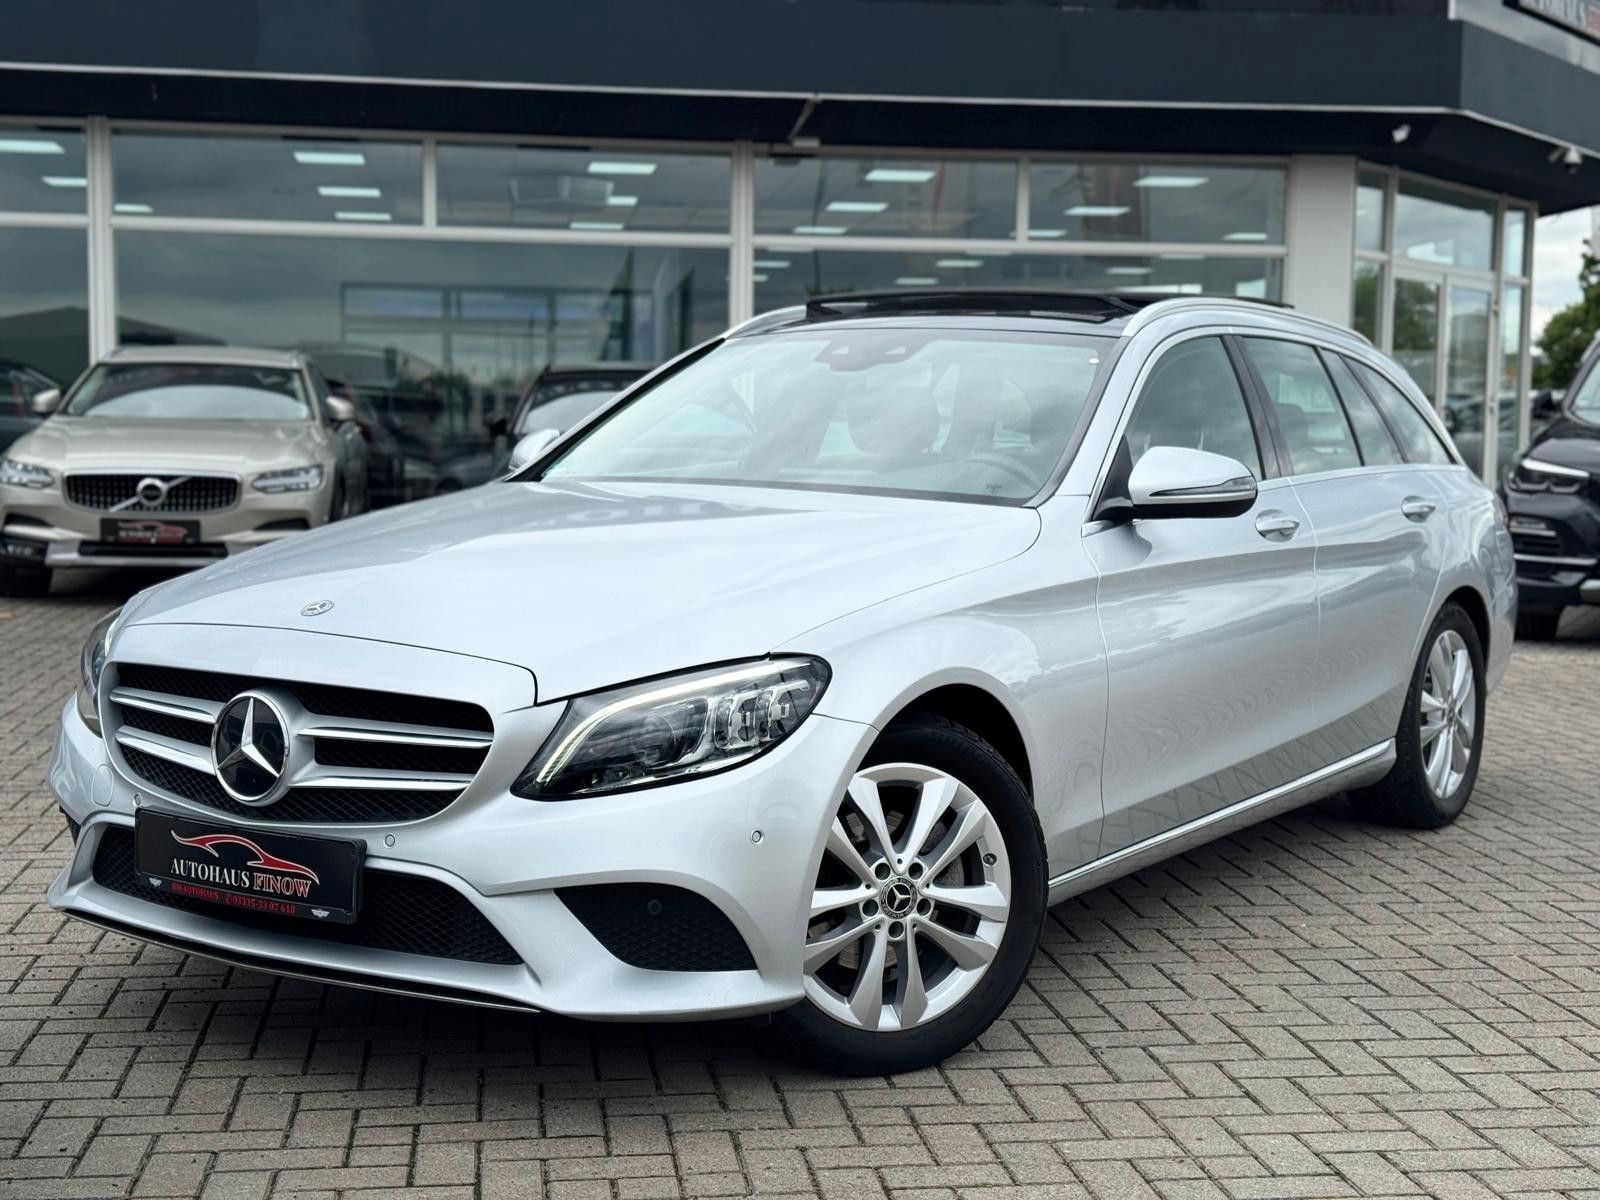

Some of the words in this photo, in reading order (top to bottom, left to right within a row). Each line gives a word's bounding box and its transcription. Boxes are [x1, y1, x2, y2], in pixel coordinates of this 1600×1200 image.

[170, 857, 250, 888] AUTOHAUS
[253, 872, 312, 898] FINOW
[184, 885, 219, 900] AUTOHAUS
